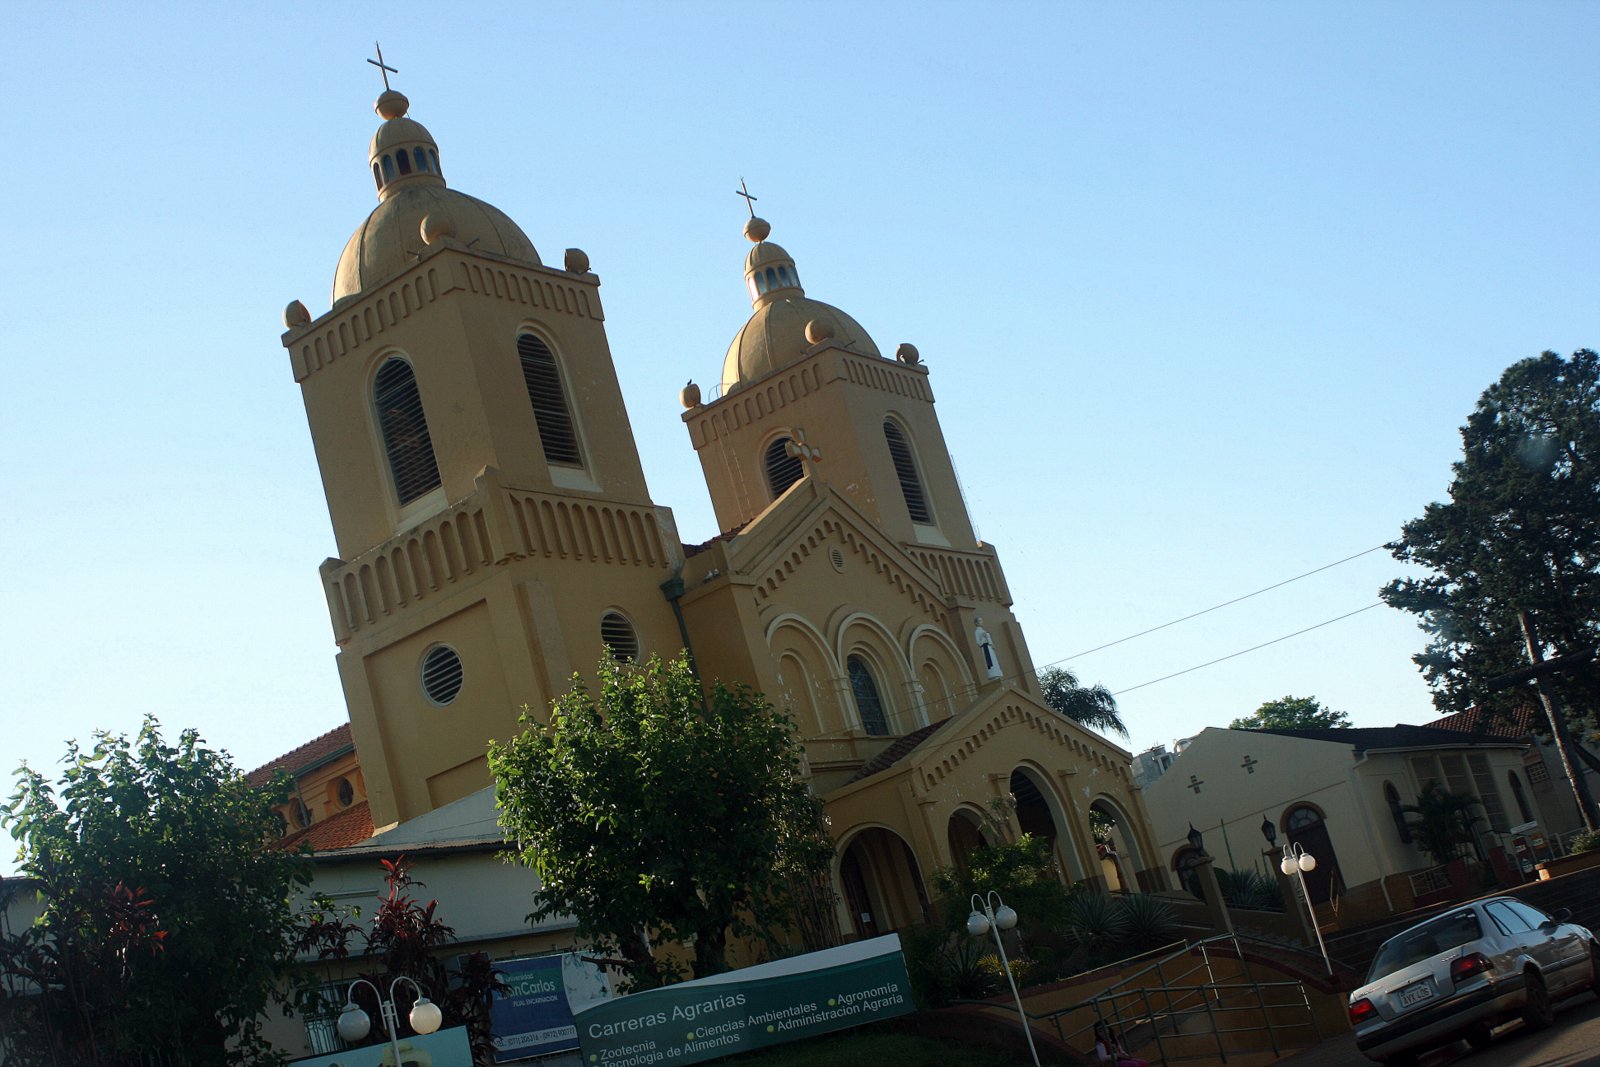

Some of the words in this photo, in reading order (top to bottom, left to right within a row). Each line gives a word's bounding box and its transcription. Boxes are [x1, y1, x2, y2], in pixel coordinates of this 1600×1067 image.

[837, 983, 899, 1006] Agronomía
[862, 994, 904, 1012] Agraria
[588, 1012, 667, 1038] Carreras
[671, 993, 746, 1021] Agrarias
[695, 1018, 745, 1039] Ciencias
[748, 1001, 818, 1027] Ambientales
[599, 1040, 657, 1061] Zootecnia
[666, 1046, 682, 1058] de
[684, 1032, 741, 1054] Alimentos
